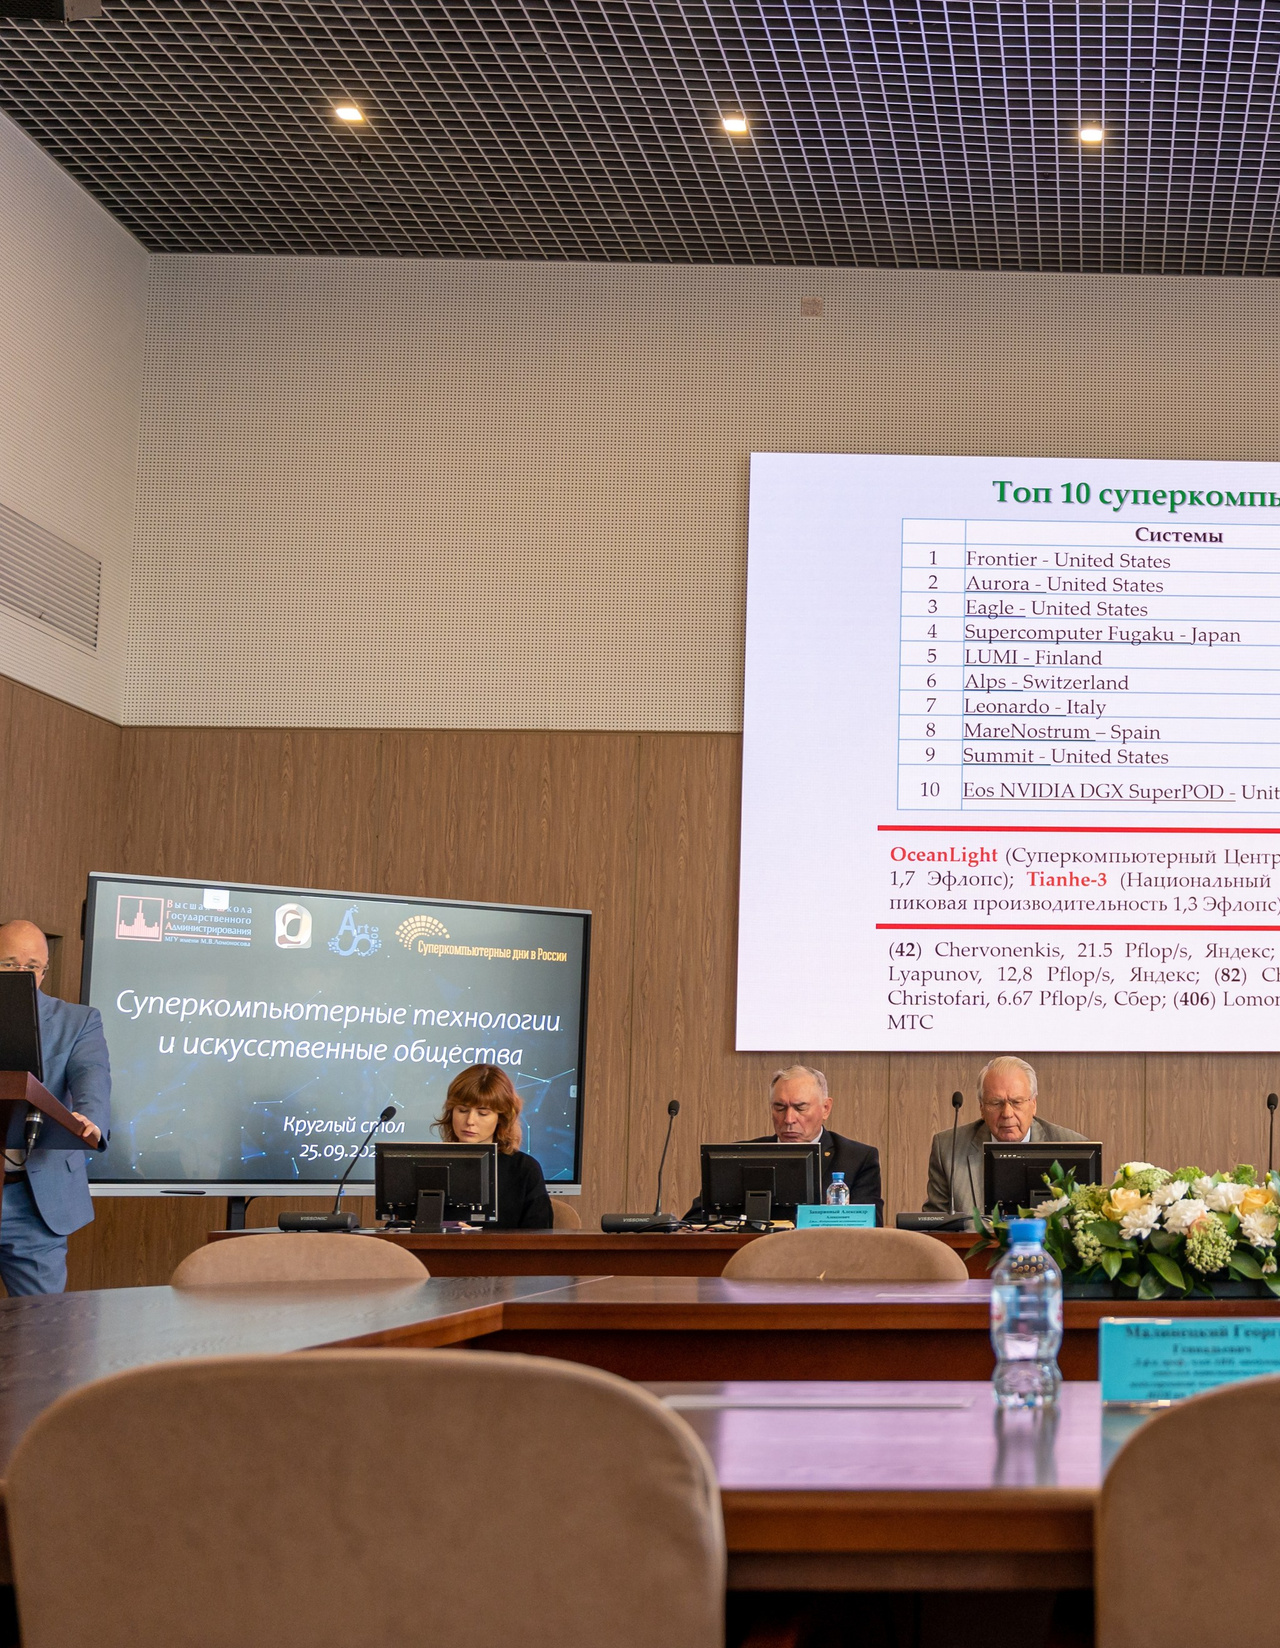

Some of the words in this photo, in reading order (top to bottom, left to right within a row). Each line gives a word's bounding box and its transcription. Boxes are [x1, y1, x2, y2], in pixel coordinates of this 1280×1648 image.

[992, 480, 1053, 504] Топ
[1060, 481, 1091, 505] 10
[1135, 526, 1224, 544] Системы
[966, 550, 1038, 567] Frontier
[1054, 552, 1114, 568] United
[1119, 553, 1171, 569] States
[965, 575, 1030, 593] Aurora
[1047, 576, 1107, 592] United
[1112, 577, 1164, 597] States
[966, 599, 1014, 620] Eagle
[1031, 600, 1091, 616] United
[1096, 601, 1148, 617] States
[964, 623, 1103, 646] Supercomputer
[1108, 625, 1175, 646] Fugaku
[1191, 626, 1241, 648] Japan
[965, 648, 1019, 668] LUMI
[1034, 649, 1104, 668] Finland
[964, 673, 1007, 694] Alps
[1020, 674, 1129, 693] Switzerland
[964, 697, 1051, 718] Leonardo
[1065, 699, 1108, 721] Italy
[963, 722, 1090, 742] MareNostrum
[1110, 724, 1161, 745] Spain
[963, 747, 1034, 763] Summit
[1051, 748, 1112, 764] United
[1117, 749, 1169, 765] States
[963, 782, 995, 798] Eos
[1000, 782, 1075, 800] NVIDIA
[1080, 783, 1124, 799] DGX
[1129, 783, 1224, 805] SuperPOD
[890, 846, 998, 868] OceanLight
[1005, 847, 1216, 869] (Суперкомпьютерный
[890, 870, 916, 889] 1,7
[927, 870, 1014, 892] Эфлопс);
[1026, 870, 1108, 887] Tianhe-3
[1120, 871, 1271, 891] (Национальный
[166, 899, 210, 911] Высша
[216, 905, 253, 914] кола
[889, 898, 967, 910] пиковая
[973, 899, 1168, 916] производительность
[1173, 896, 1198, 915] 1,3
[165, 921, 252, 936] Администрирования
[166, 910, 252, 925] Государственного
[418, 939, 511, 960] Суперкомпьютерные
[512, 948, 529, 960] дни
[530, 950, 537, 960] в
[537, 947, 568, 962] России
[888, 942, 922, 961] (42)
[934, 941, 1065, 961] Chervonenkis,
[1077, 942, 1113, 958] 21.5
[1125, 942, 1192, 964] Pflop/s,
[1205, 942, 1275, 961] Яндекс;
[888, 965, 982, 987] Lyapunov,
[999, 966, 1033, 984] 12,8
[1047, 965, 1115, 988] Pflop/s,
[1129, 966, 1200, 985] Яндекс;
[1214, 967, 1247, 986] (82)
[116, 989, 407, 1029] Суперкомпьютерные
[412, 1008, 561, 1032] технологии
[887, 989, 990, 1009] Christofari,
[997, 990, 1033, 1006] 6.67
[1039, 989, 1107, 1012] Pflop/s,
[1114, 990, 1166, 1012] Сбер;
[1173, 991, 1216, 1010] (406)
[887, 1014, 934, 1030] МТС
[158, 1035, 176, 1054] и
[183, 1036, 388, 1063] искусственные
[394, 1039, 523, 1069] общества
[283, 1116, 356, 1136] Круглый
[360, 1120, 406, 1133] стол
[299, 1144, 377, 1161] 25.09.202
